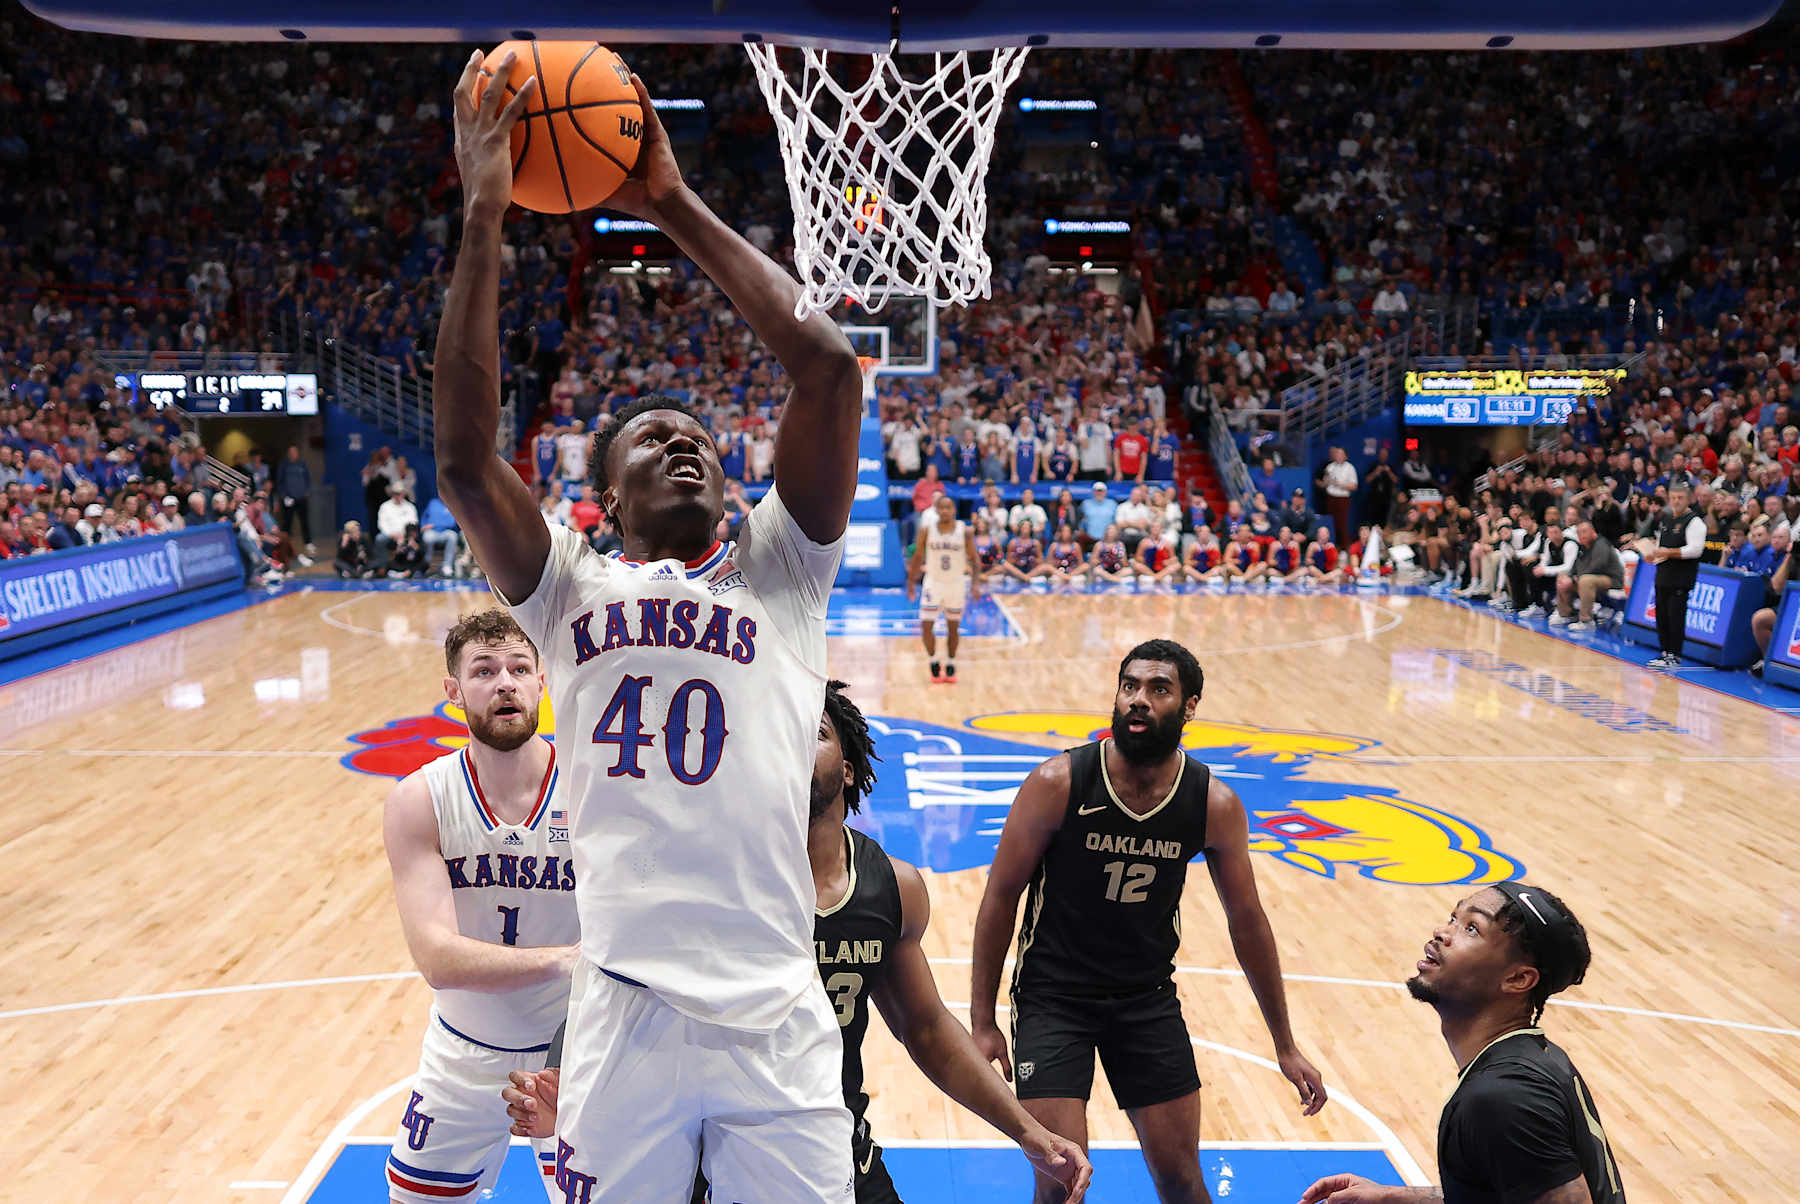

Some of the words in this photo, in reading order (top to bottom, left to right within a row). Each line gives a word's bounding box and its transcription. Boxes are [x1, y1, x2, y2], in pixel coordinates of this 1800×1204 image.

[4, 569, 84, 622] SHELTER
[80, 550, 171, 603] INSURANCE
[570, 598, 757, 667] KANSAS
[1685, 609, 1718, 634] RANCE
[592, 674, 729, 786] 40
[1085, 832, 1182, 859] OAKLAND
[445, 853, 577, 892] KANSAS
[1103, 861, 1157, 903] 12
[497, 905, 521, 946] 1
[814, 940, 883, 964] LAND
[825, 972, 864, 1028] 3
[402, 1090, 434, 1150] KU
[555, 1135, 597, 1204] KU
